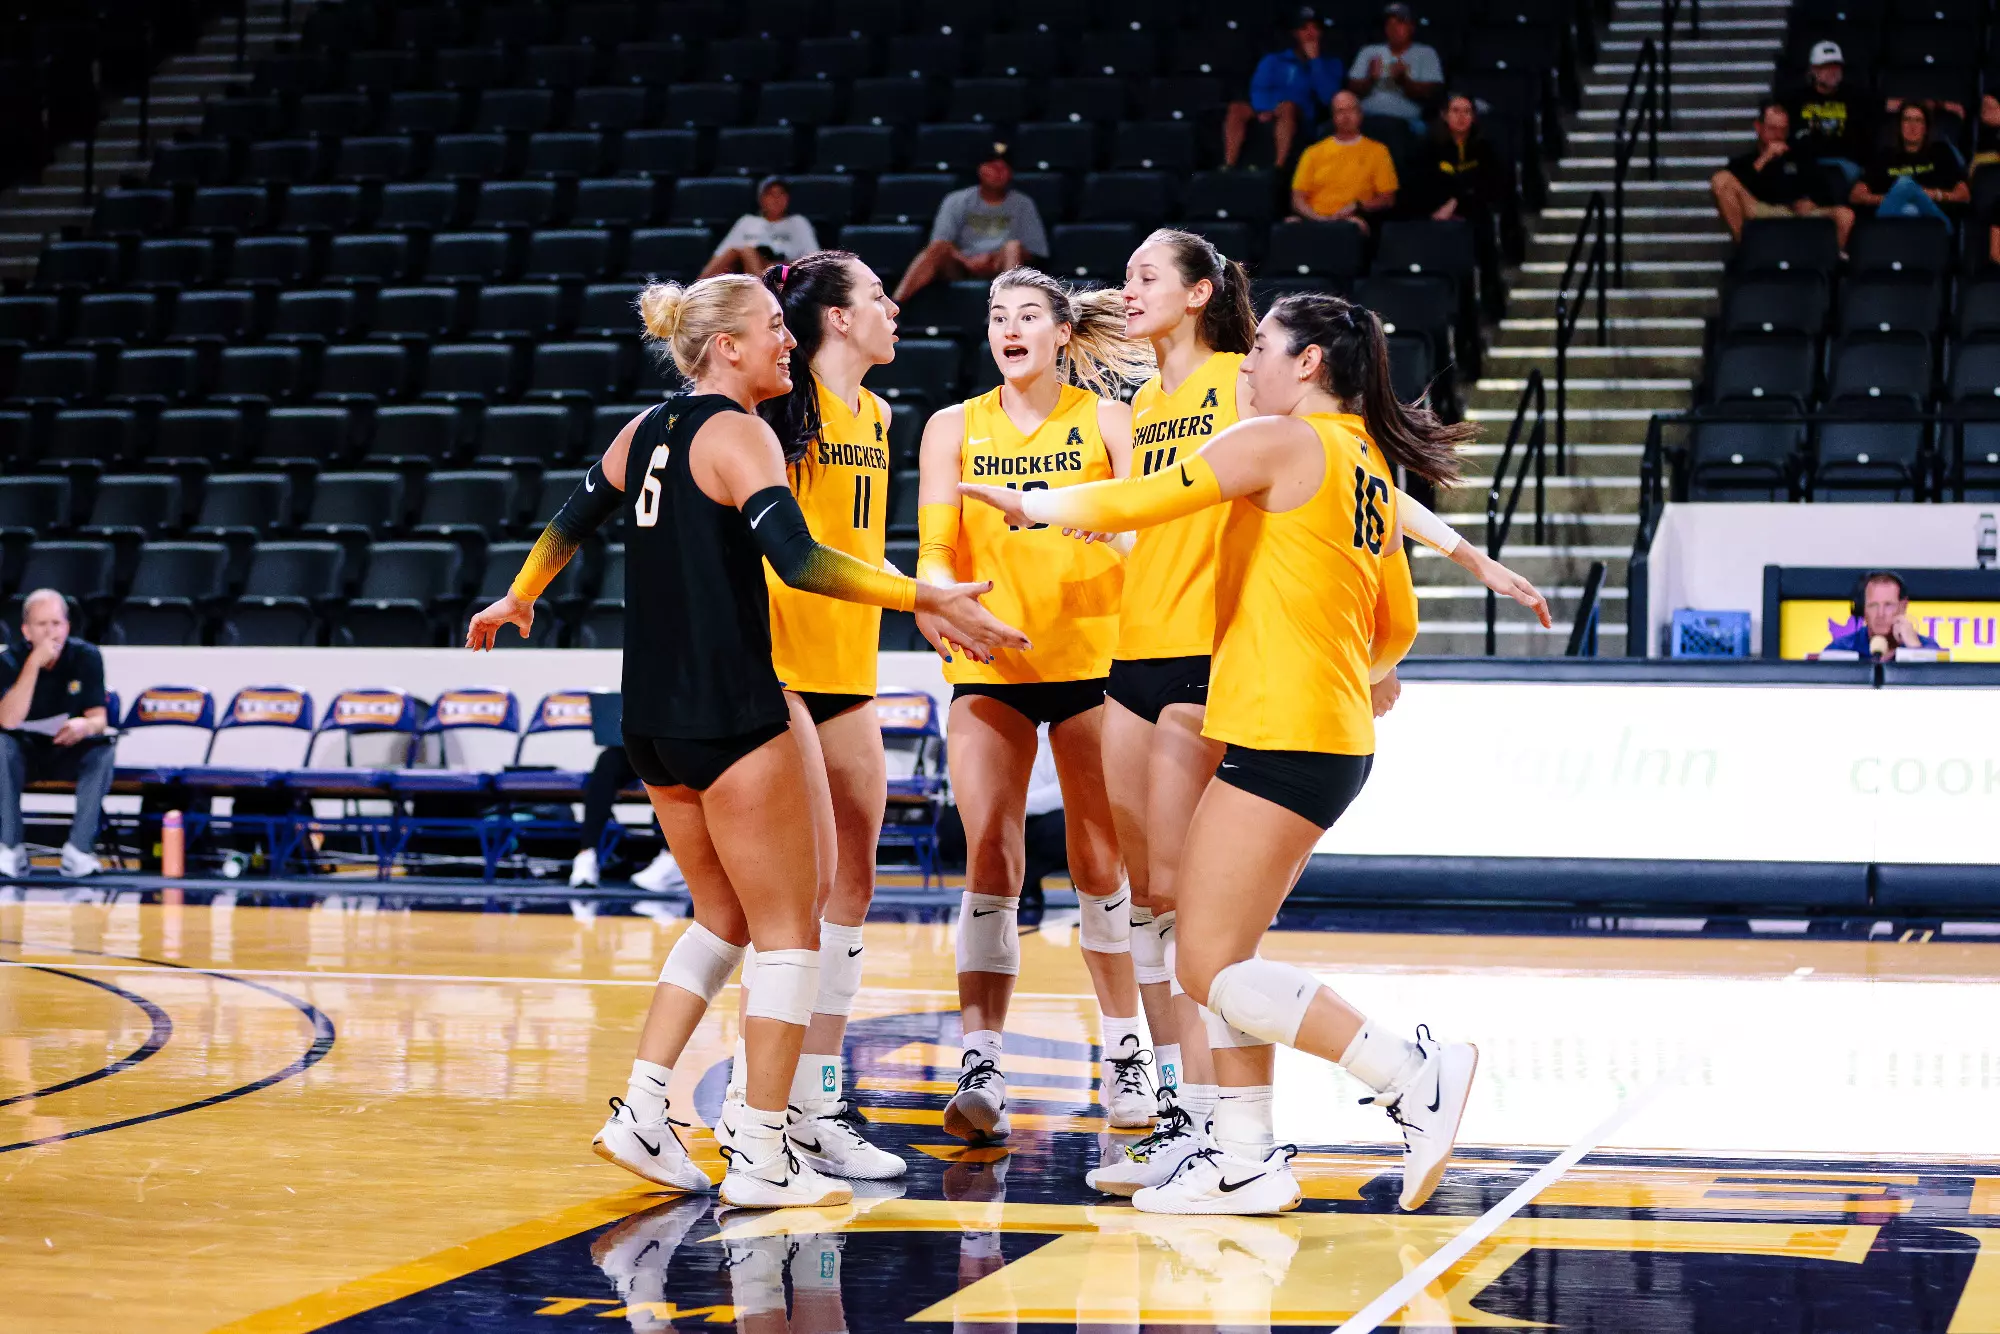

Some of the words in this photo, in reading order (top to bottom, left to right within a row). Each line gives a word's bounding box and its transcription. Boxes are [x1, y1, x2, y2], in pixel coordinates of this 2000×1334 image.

[1132, 413, 1214, 449] SHOCKERS
[818, 442, 887, 470] SHOCKERS
[973, 450, 1082, 476] SHOCKERS
[634, 443, 671, 527] 6
[853, 474, 871, 529] 11
[1353, 465, 1389, 555] 16
[139, 698, 201, 714] TECH
[237, 699, 300, 715] TECH
[336, 700, 400, 716] TECH
[440, 701, 504, 717] TECH
